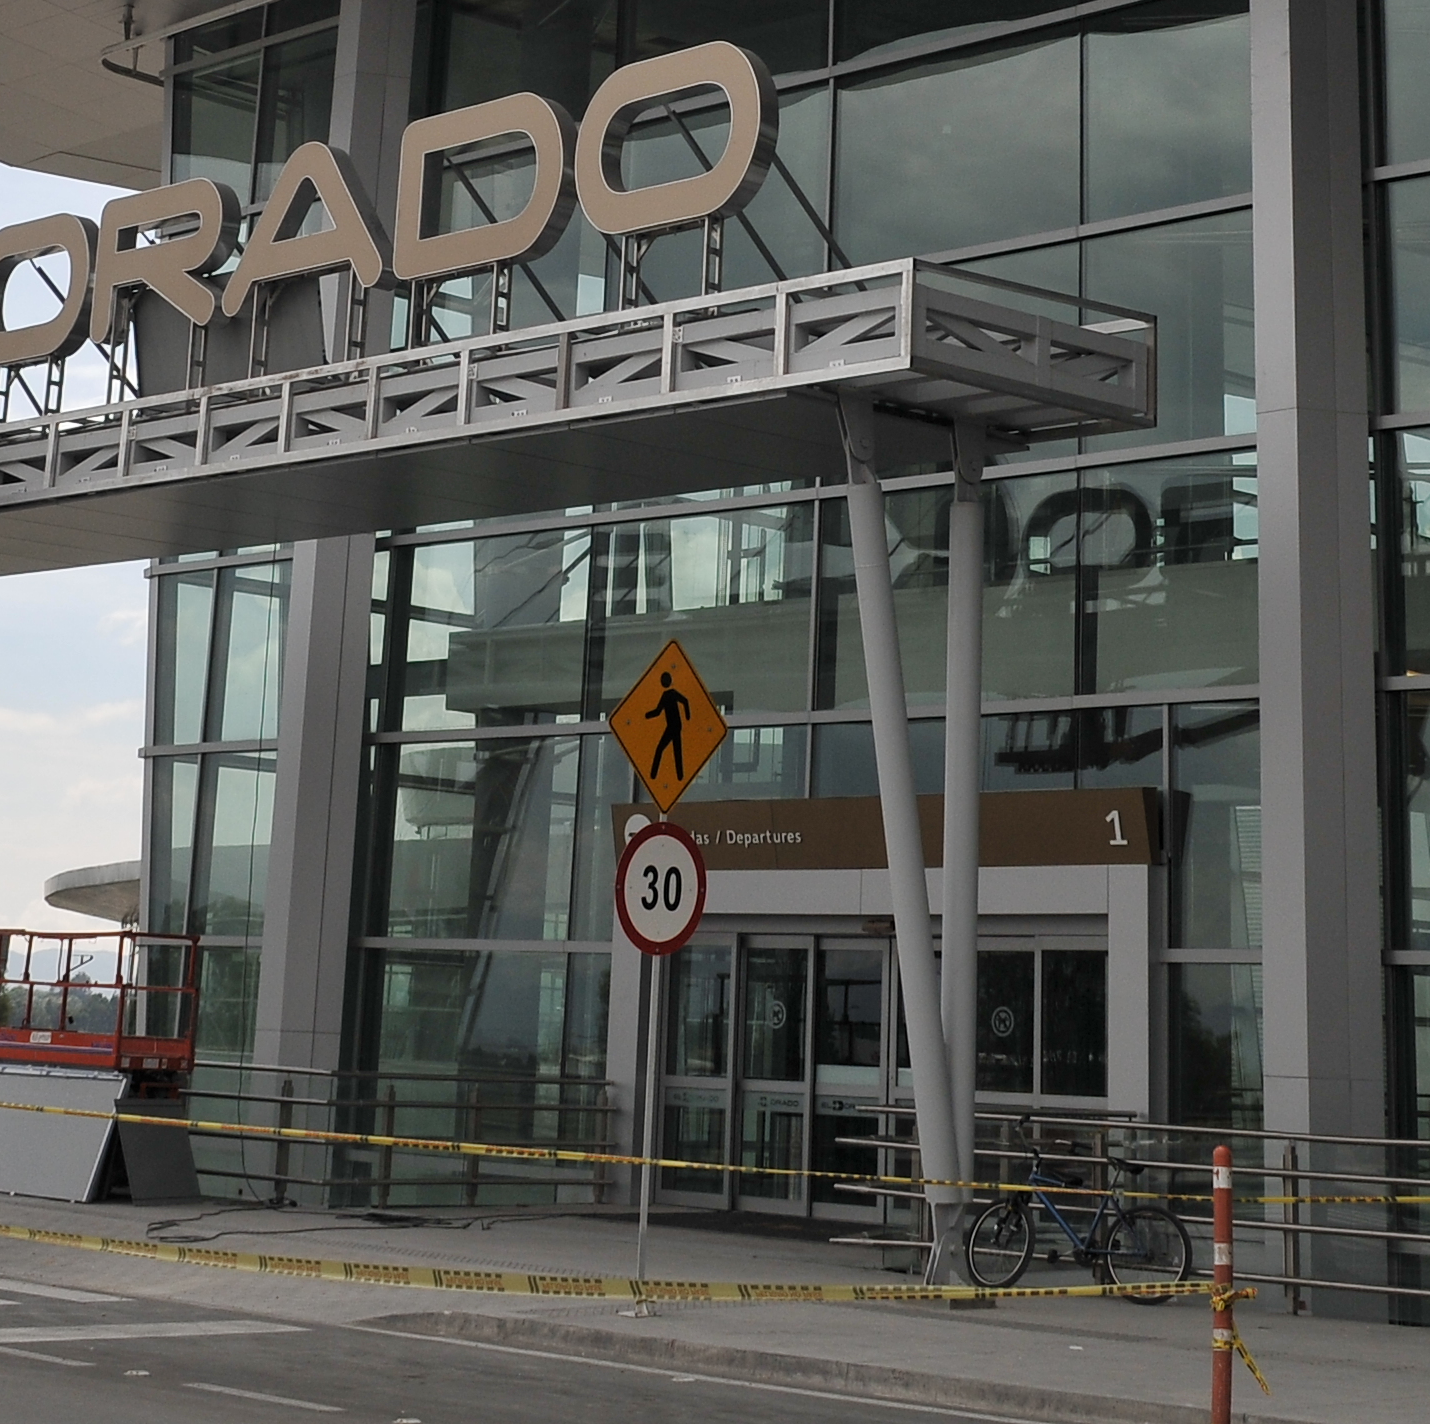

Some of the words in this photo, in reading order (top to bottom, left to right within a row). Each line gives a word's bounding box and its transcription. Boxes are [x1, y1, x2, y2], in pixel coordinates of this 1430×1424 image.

[726, 829, 802, 848] Departures
[1105, 810, 1128, 846] 1
[641, 865, 682, 911] 30
